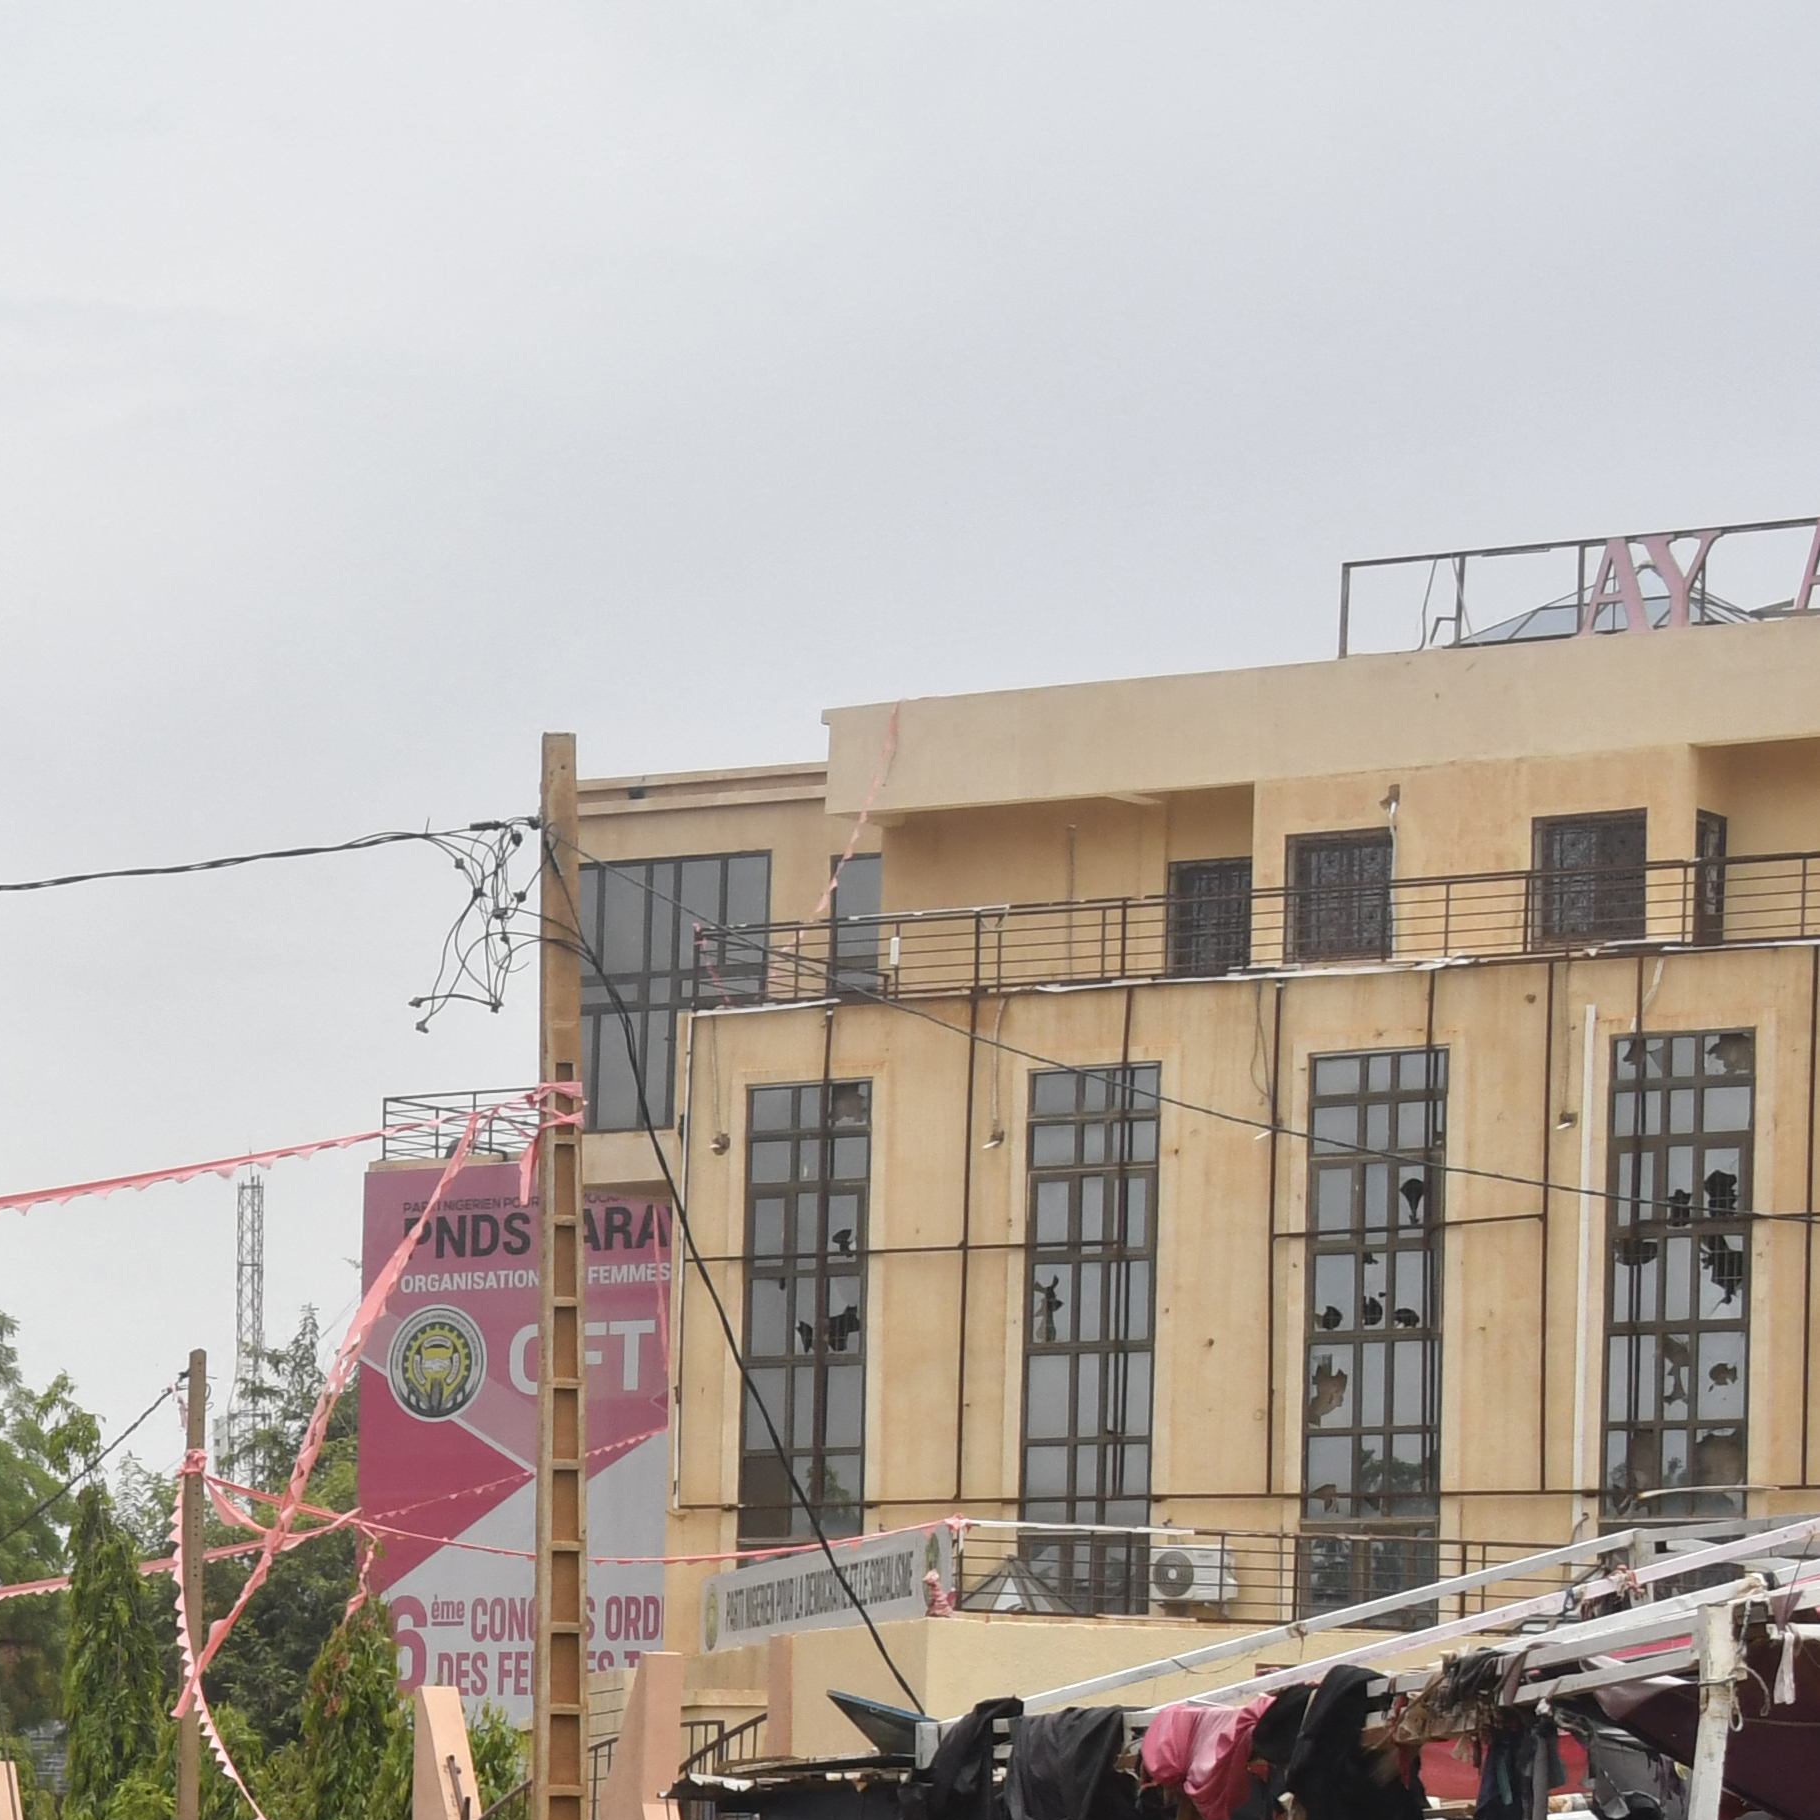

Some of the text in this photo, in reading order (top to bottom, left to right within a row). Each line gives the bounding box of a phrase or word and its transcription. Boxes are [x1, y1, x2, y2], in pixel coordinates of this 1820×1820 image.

[403, 1199, 441, 1213] PARI
[403, 1212, 531, 1260] PNDS
[588, 1262, 671, 1285] FEMMES
[438, 1651, 489, 1697] DES
